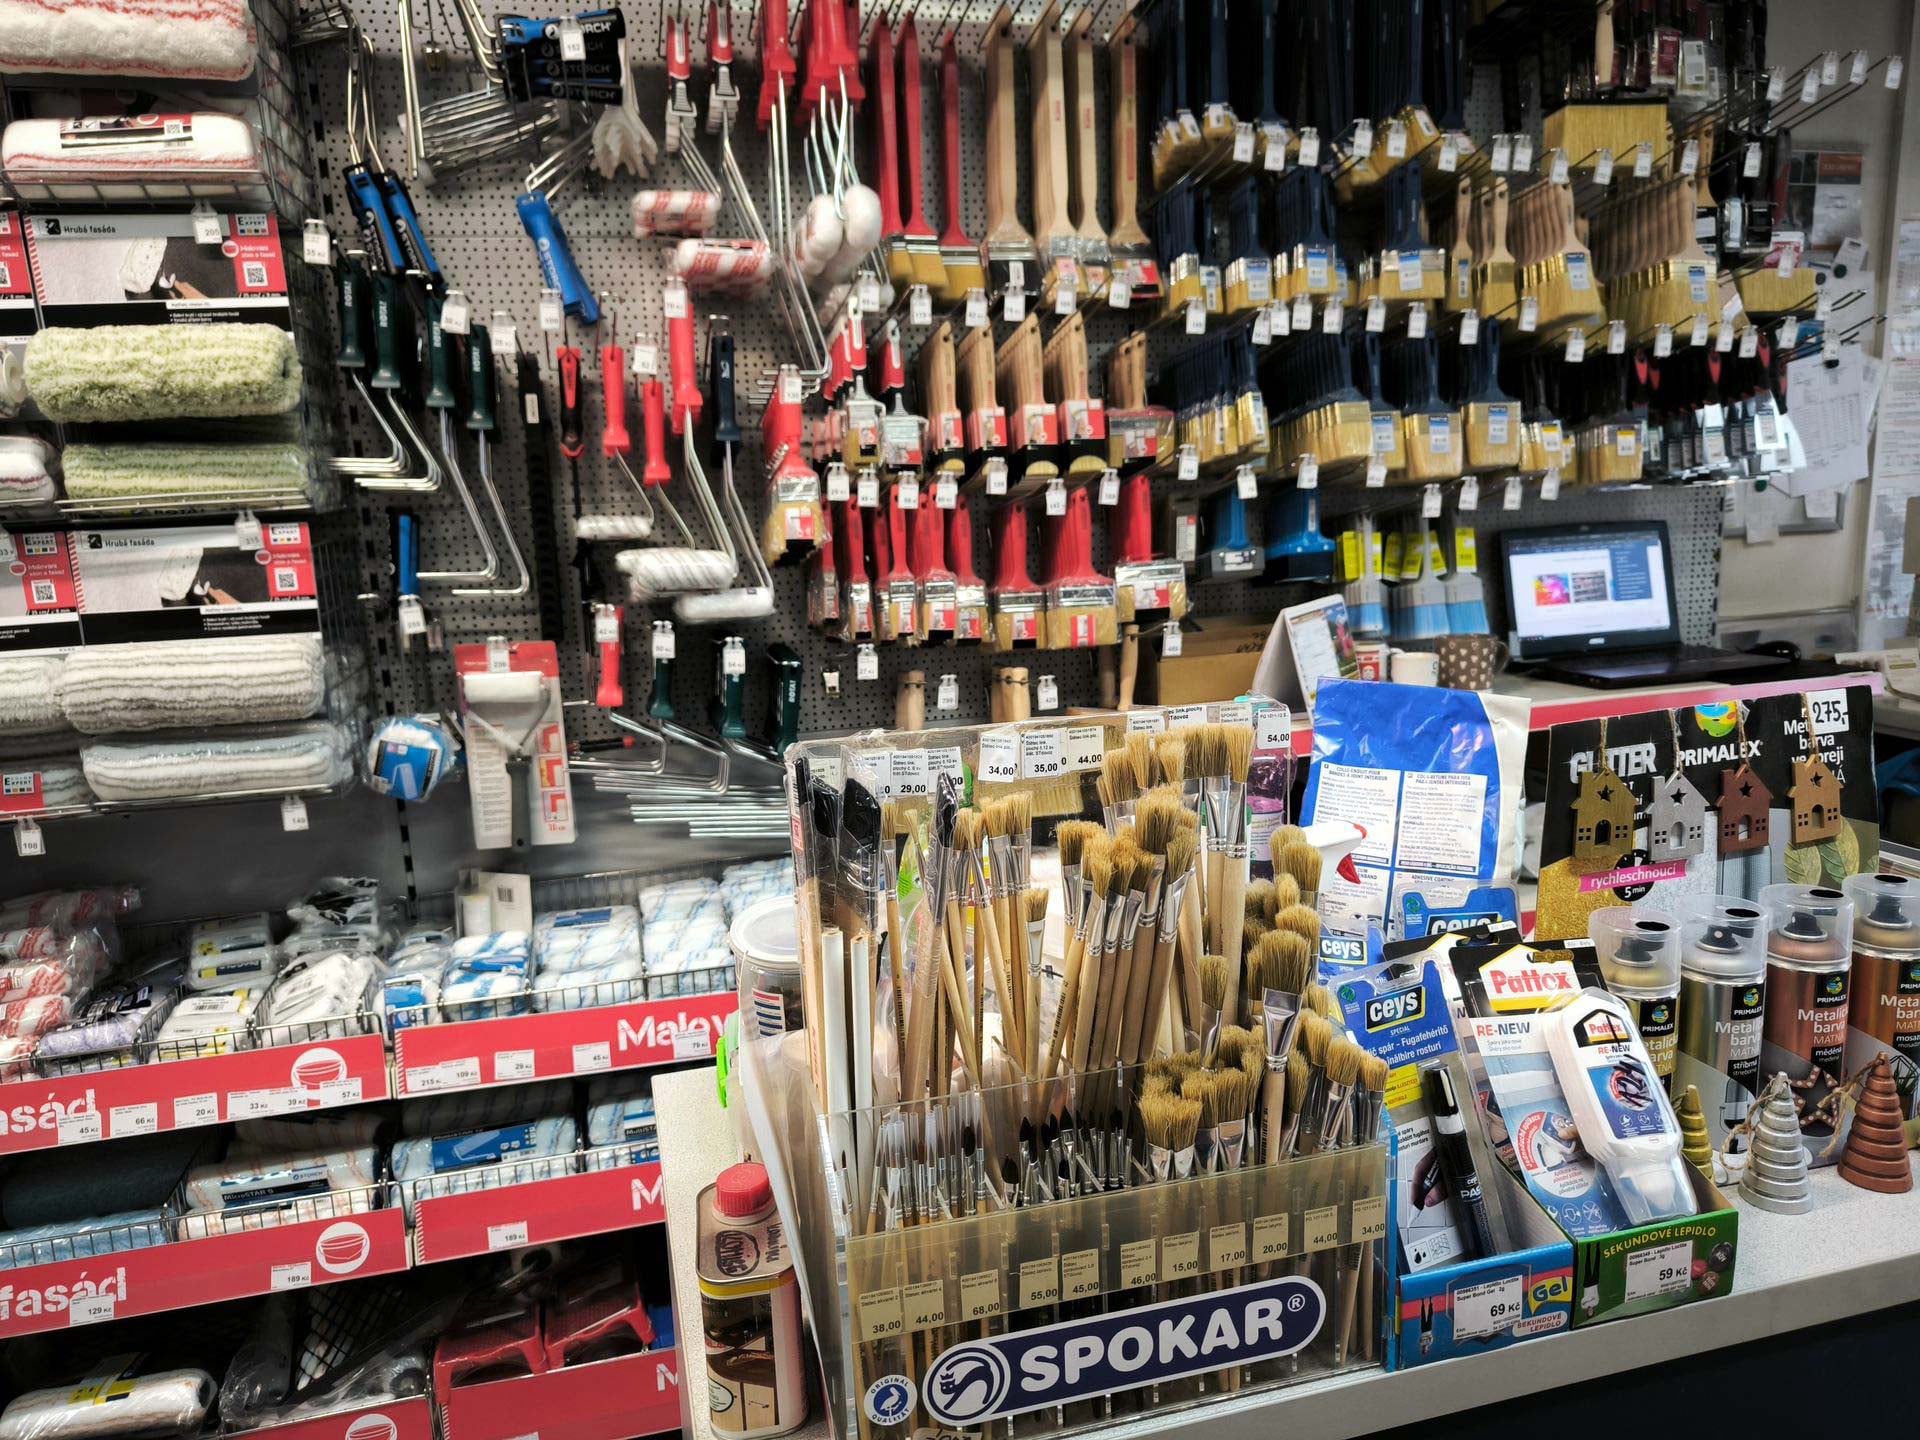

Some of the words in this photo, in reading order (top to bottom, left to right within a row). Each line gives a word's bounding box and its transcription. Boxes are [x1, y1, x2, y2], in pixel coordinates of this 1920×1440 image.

[64, 224, 88, 234] Hrubá
[89, 225, 117, 234] fasáda
[105, 538, 129, 548] Hrubá
[130, 538, 155, 547] fasáda
[1267, 733, 1290, 743] 54,00
[1078, 754, 1102, 764] 44,00
[1675, 739, 1761, 767] PRIMALEX
[988, 765, 1014, 776] 34,00
[1034, 763, 1058, 773] 35,00
[900, 784, 926, 794] 29,00
[1590, 863, 1677, 889] rychleschnoucí
[1624, 886, 1632, 898] 5
[1632, 885, 1646, 894] min
[1321, 940, 1362, 959] ceys
[1489, 968, 1573, 994] Pattex
[1816, 994, 1847, 1004] PRIMALEX
[1369, 991, 1419, 1023] ceys
[1476, 1021, 1531, 1037] RE-NEW
[1642, 1022, 1674, 1033] PRIMALEX
[1416, 1041, 1442, 1057] rosturi
[1597, 1044, 1631, 1055] RE-NEW
[1651, 1051, 1673, 1063] arva
[342, 1091, 351, 1099] 57
[249, 1102, 259, 1111] 33
[288, 1098, 298, 1106] 39
[135, 1117, 146, 1126] 66
[79, 1126, 90, 1135] 45
[91, 1125, 99, 1133] Kč
[1361, 1223, 1385, 1236] 34,00
[1313, 1232, 1338, 1245] 44,00
[1603, 1225, 1672, 1259] SEKUNDOVÉ
[1674, 1226, 1716, 1237] LEPIDLO
[1262, 1242, 1288, 1255] 20,00
[1220, 1250, 1245, 1263] 17,00
[1172, 1260, 1198, 1273] 15,00
[287, 1275, 300, 1283] 189
[301, 1274, 310, 1282] Kč
[1130, 1273, 1156, 1286] 46,00
[1659, 1267, 1673, 1281] 59
[1675, 1267, 1688, 1277] Kč
[1030, 1288, 1058, 1301] 55,00
[1072, 1281, 1099, 1295] 45,00
[1532, 1275, 1569, 1303] Gel
[1456, 1294, 1472, 1302] Super
[88, 1307, 103, 1316] 129
[103, 1306, 112, 1314] Kč
[972, 1301, 1000, 1316] 68,00
[1490, 1303, 1506, 1317] 69
[1508, 1303, 1521, 1313] Kč
[915, 1311, 944, 1325] 44,00
[1517, 1312, 1562, 1329] SEKUNDOVÉ
[872, 1320, 901, 1334] 38,00
[1530, 1320, 1561, 1333] LEPIDLO
[870, 1377, 909, 1394] ORIGINAL
